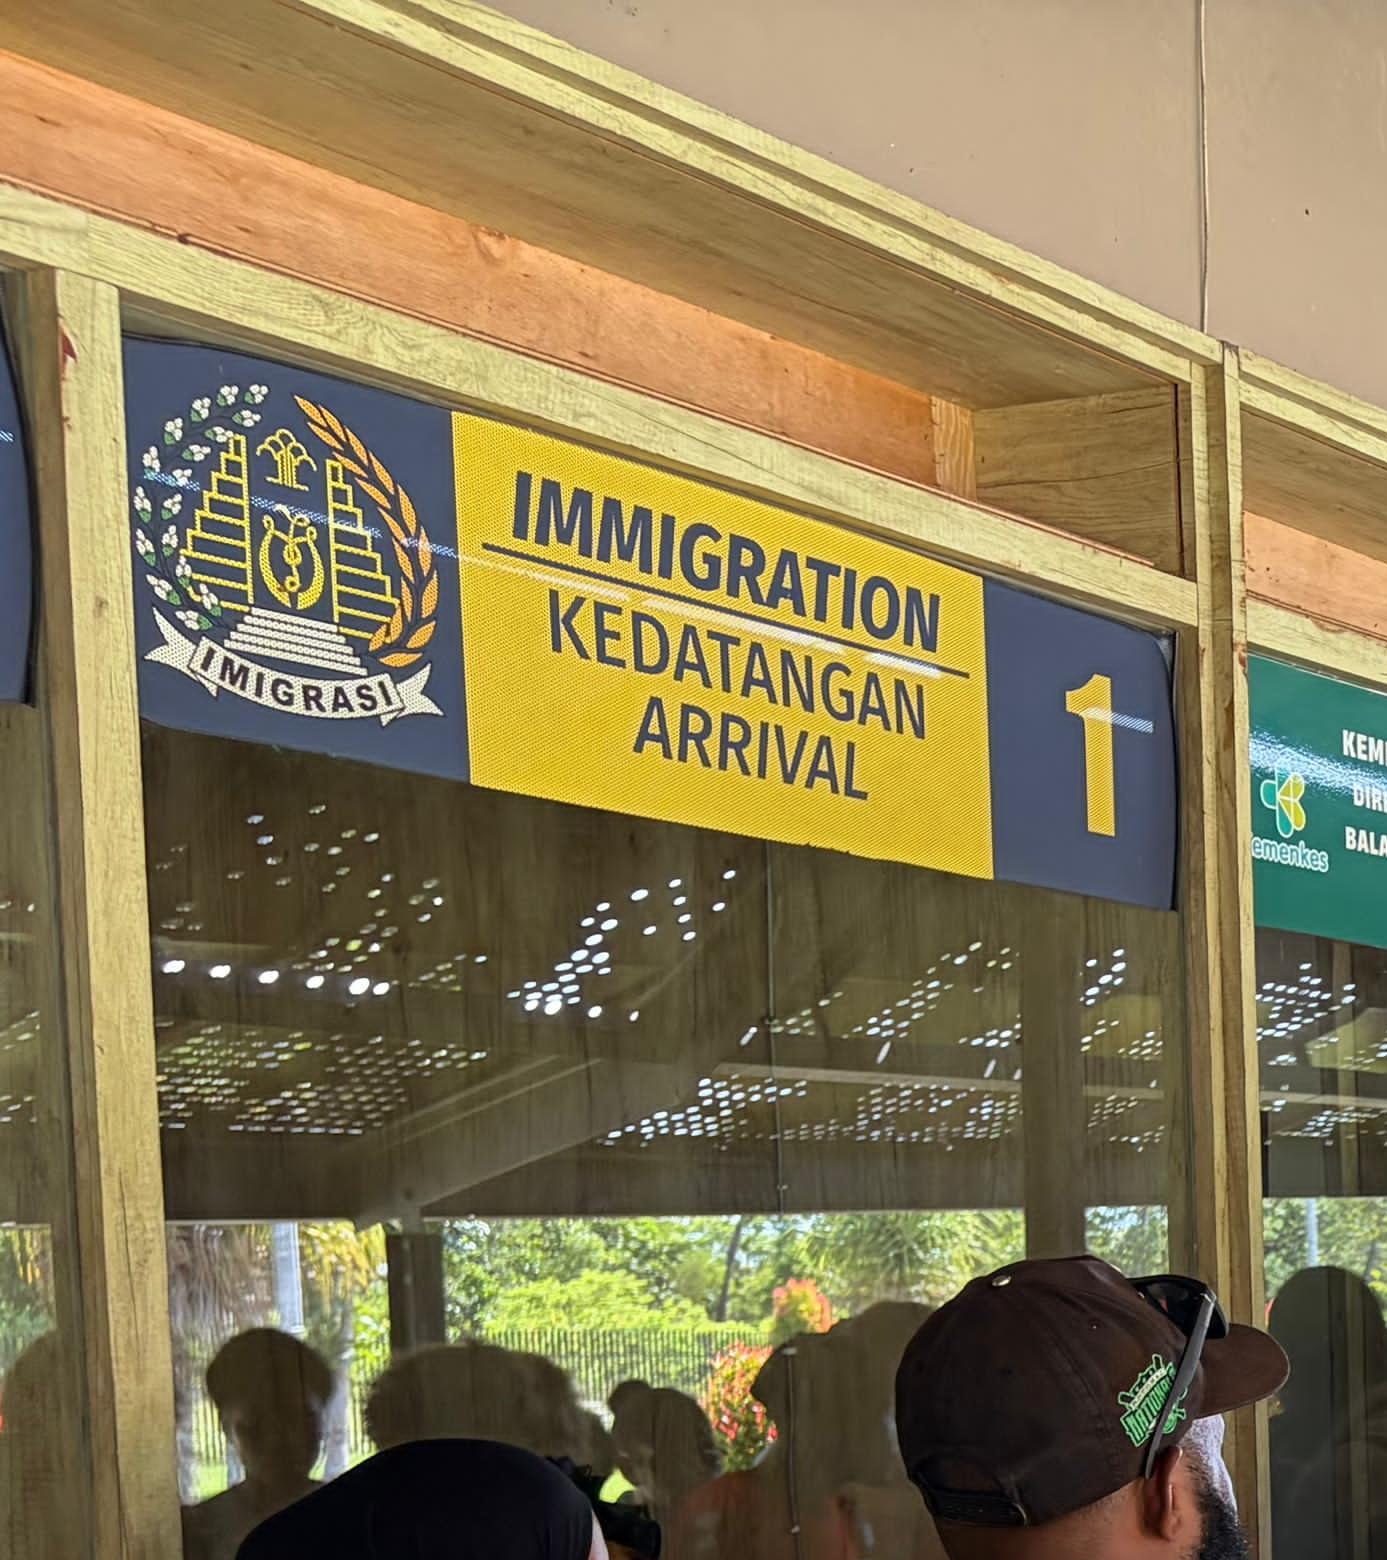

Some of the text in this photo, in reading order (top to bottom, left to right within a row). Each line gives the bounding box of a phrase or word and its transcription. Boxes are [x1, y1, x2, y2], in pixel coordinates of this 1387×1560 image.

[511, 470, 940, 654] IMMIGRATION
[200, 646, 393, 713] IMIGRASI
[548, 588, 926, 740] KEDATANGAN
[633, 695, 868, 801] ARRIVAL
[1065, 673, 1116, 837] 1
[1250, 836, 1329, 873] emenkes
